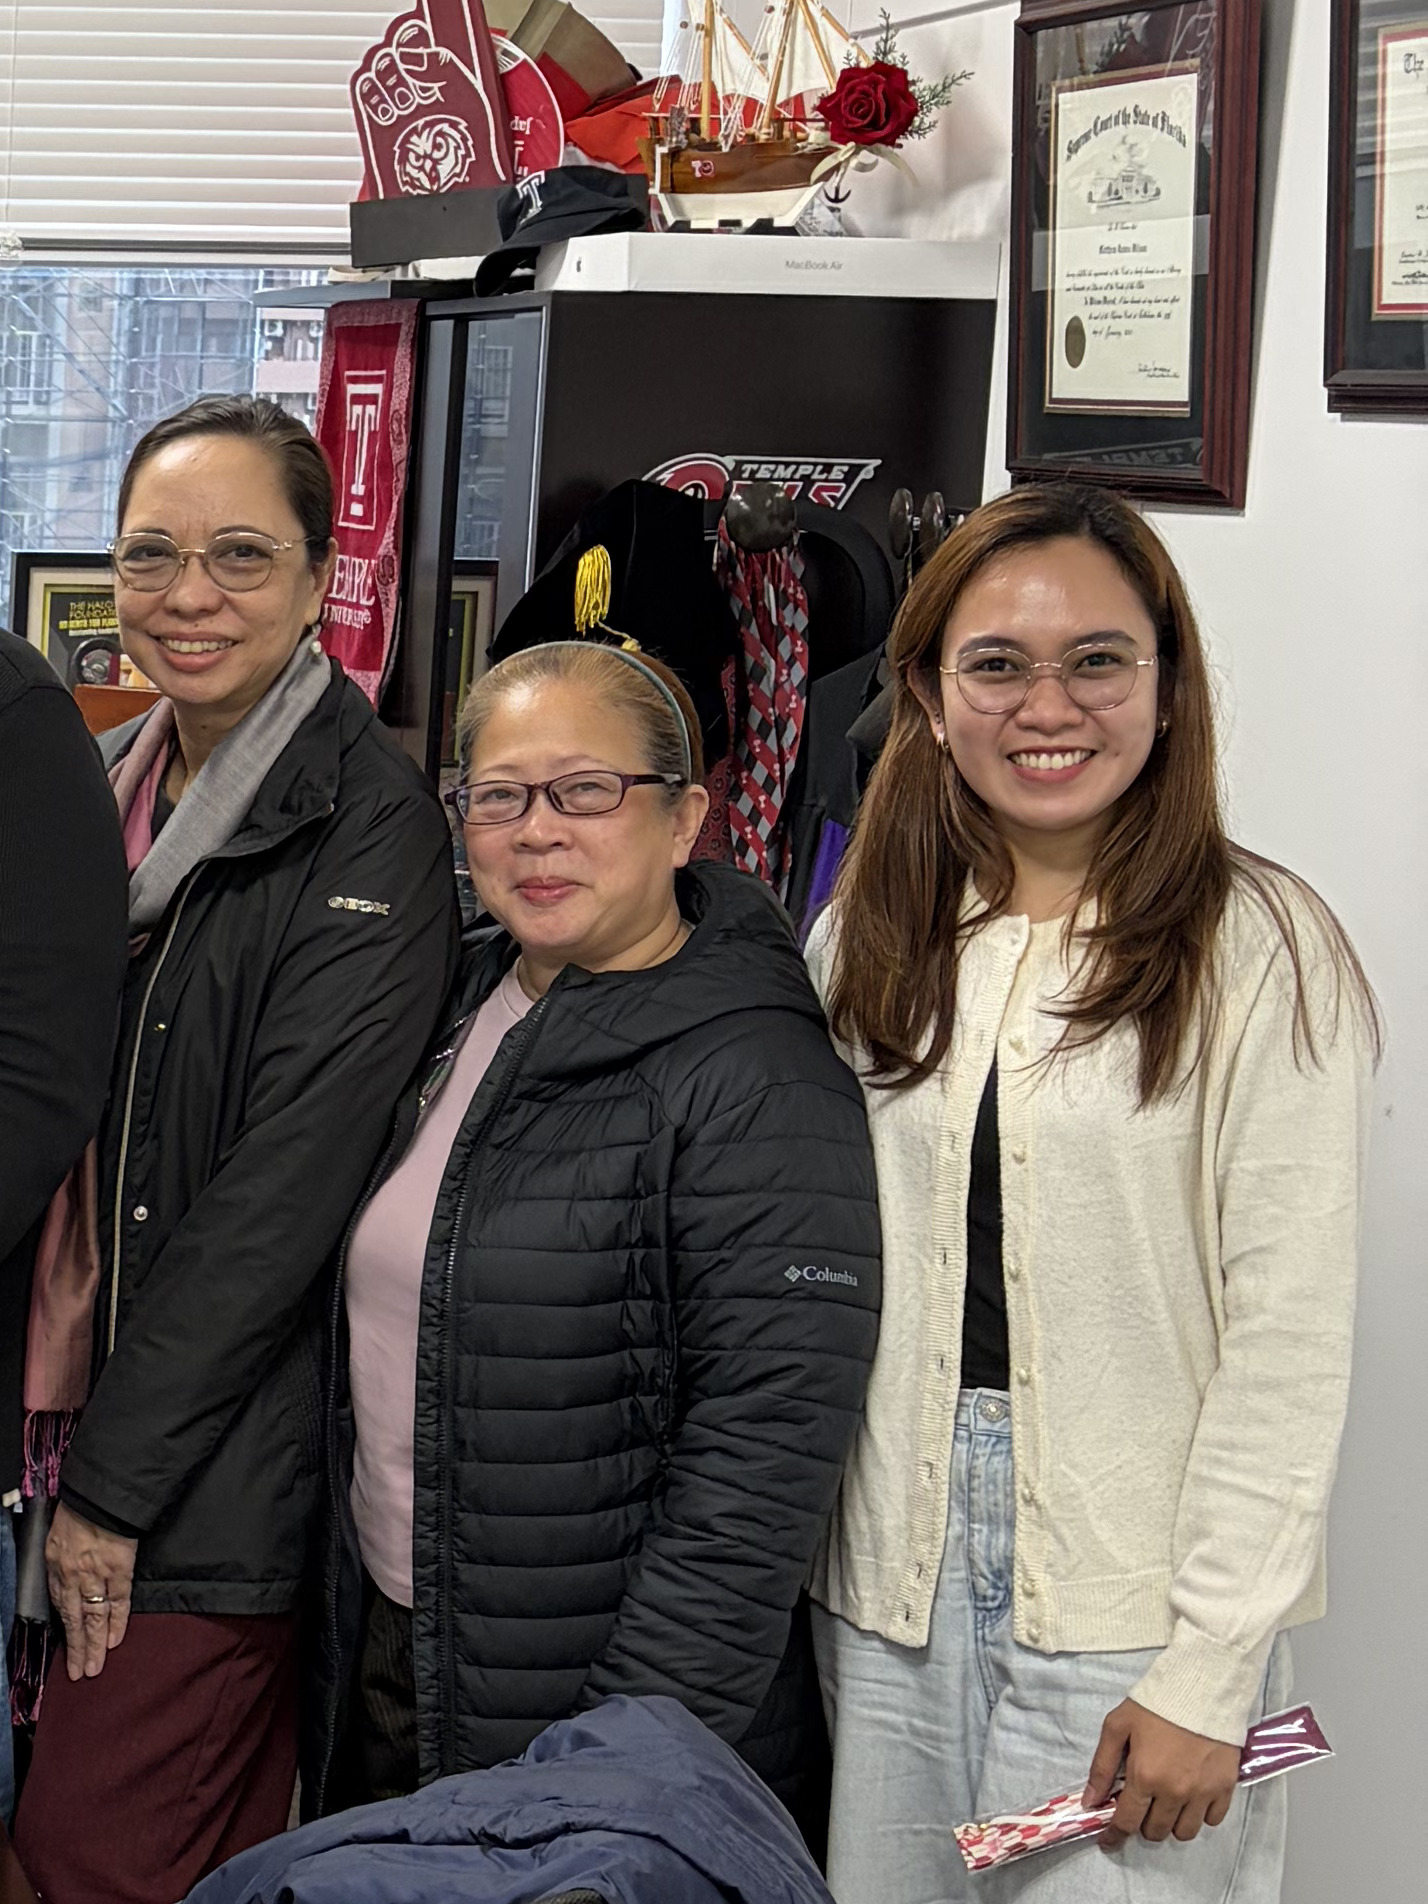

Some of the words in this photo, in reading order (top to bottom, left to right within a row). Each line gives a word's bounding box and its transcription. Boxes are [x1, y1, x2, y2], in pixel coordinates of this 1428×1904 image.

[785, 260, 828, 270] MacBook
[830, 261, 843, 270] Air
[345, 380, 384, 519] T
[740, 464, 850, 480] TEMPLE
[327, 554, 377, 607] EMPLE
[803, 1266, 858, 1287] Columbia
